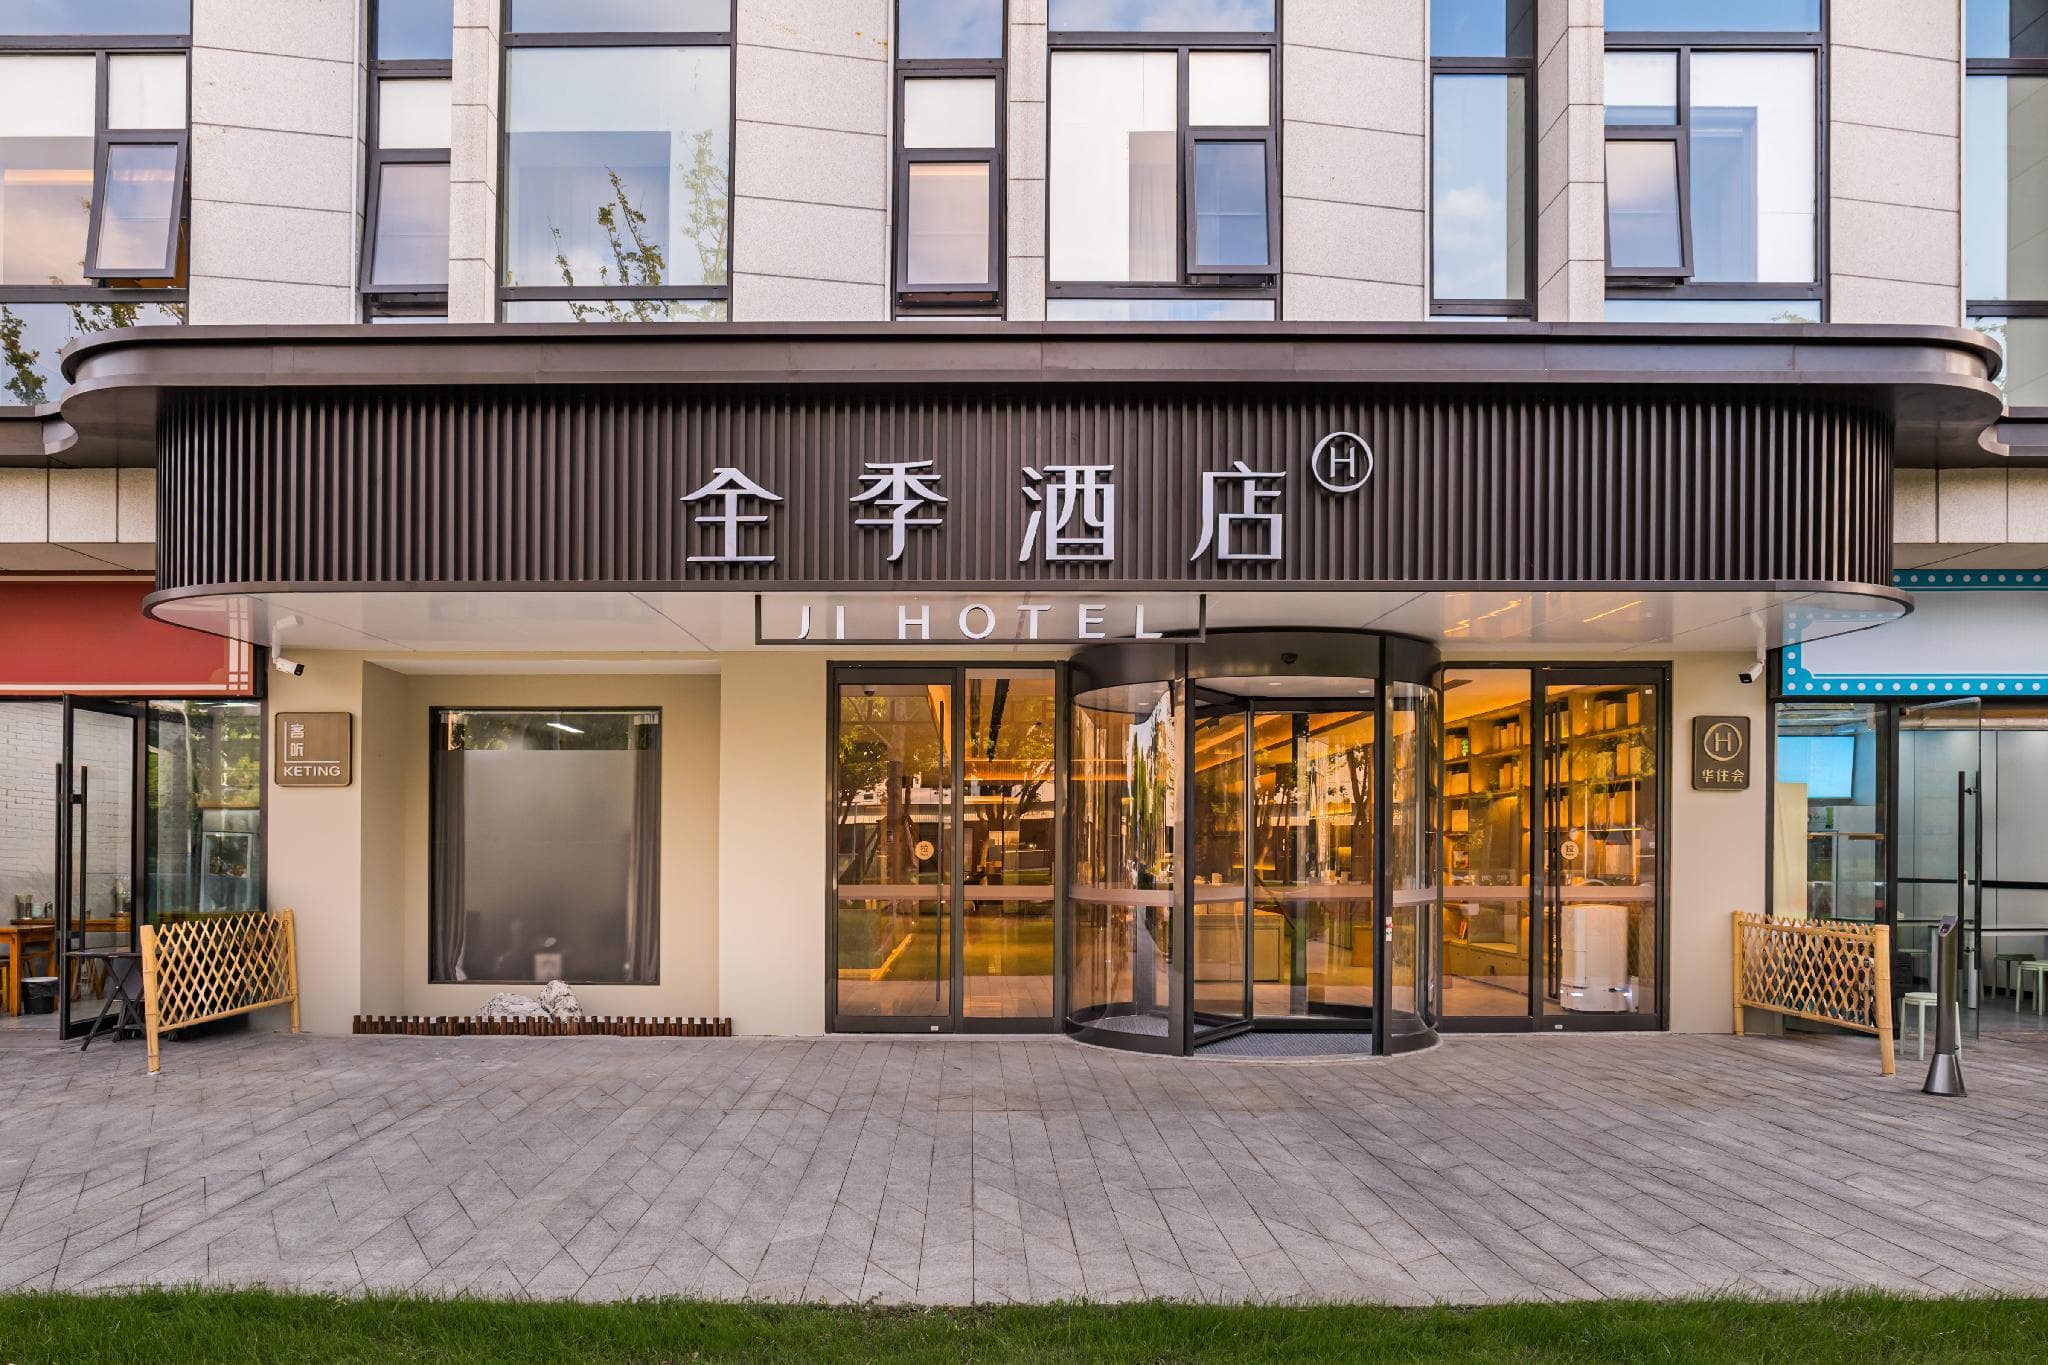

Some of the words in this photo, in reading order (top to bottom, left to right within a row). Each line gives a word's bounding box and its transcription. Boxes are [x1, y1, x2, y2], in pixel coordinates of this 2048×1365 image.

[680, 459, 1287, 562] 全季酒店
[797, 604, 846, 640] JI
[899, 603, 1163, 640] HOTEL
[283, 766, 341, 777] KETING
[1701, 768, 1745, 783] 华住会
